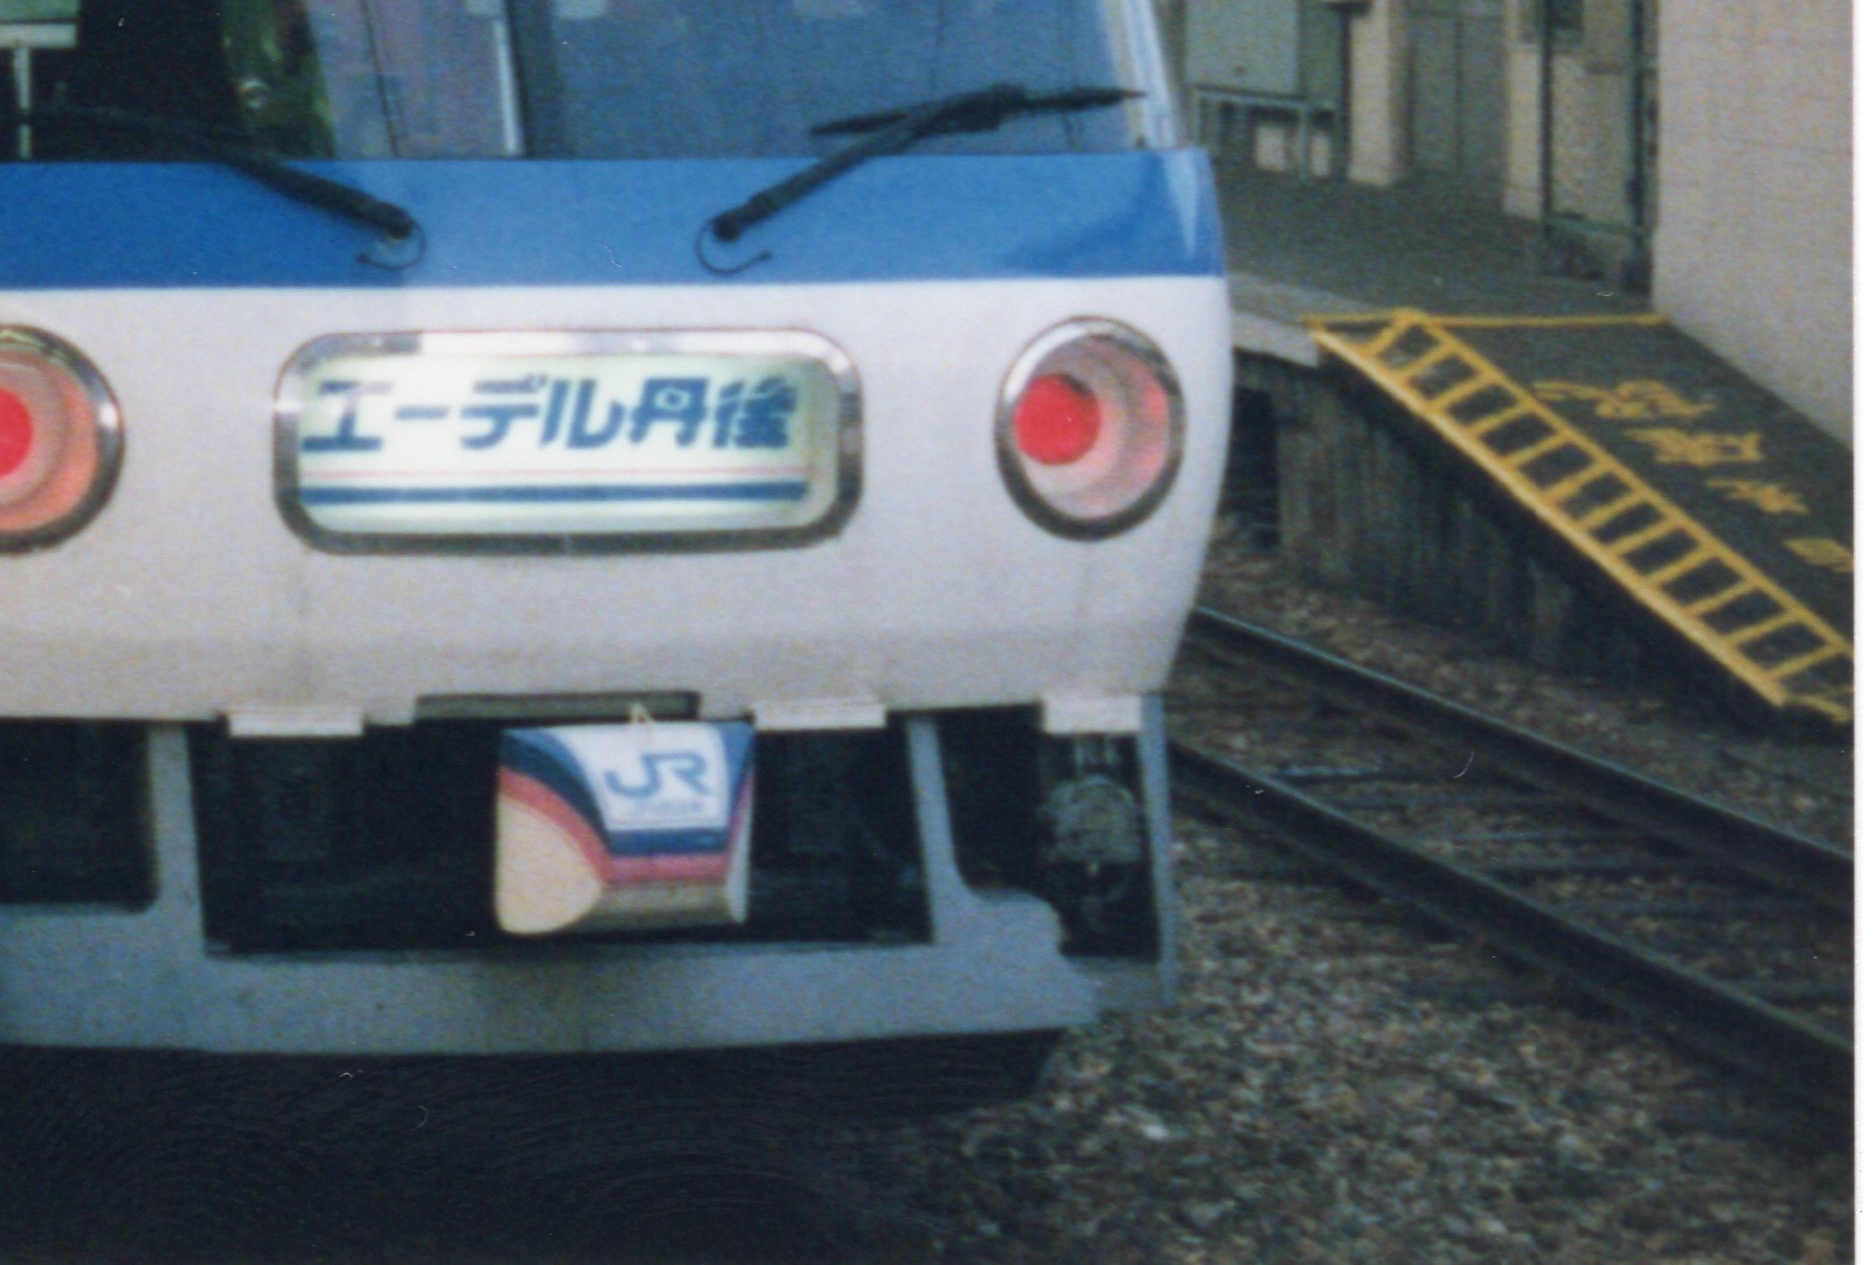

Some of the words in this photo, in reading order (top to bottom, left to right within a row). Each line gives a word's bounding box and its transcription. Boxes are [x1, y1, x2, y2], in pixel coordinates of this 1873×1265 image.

[300, 373, 799, 453] エーデル丹後
[603, 751, 712, 799] JR
